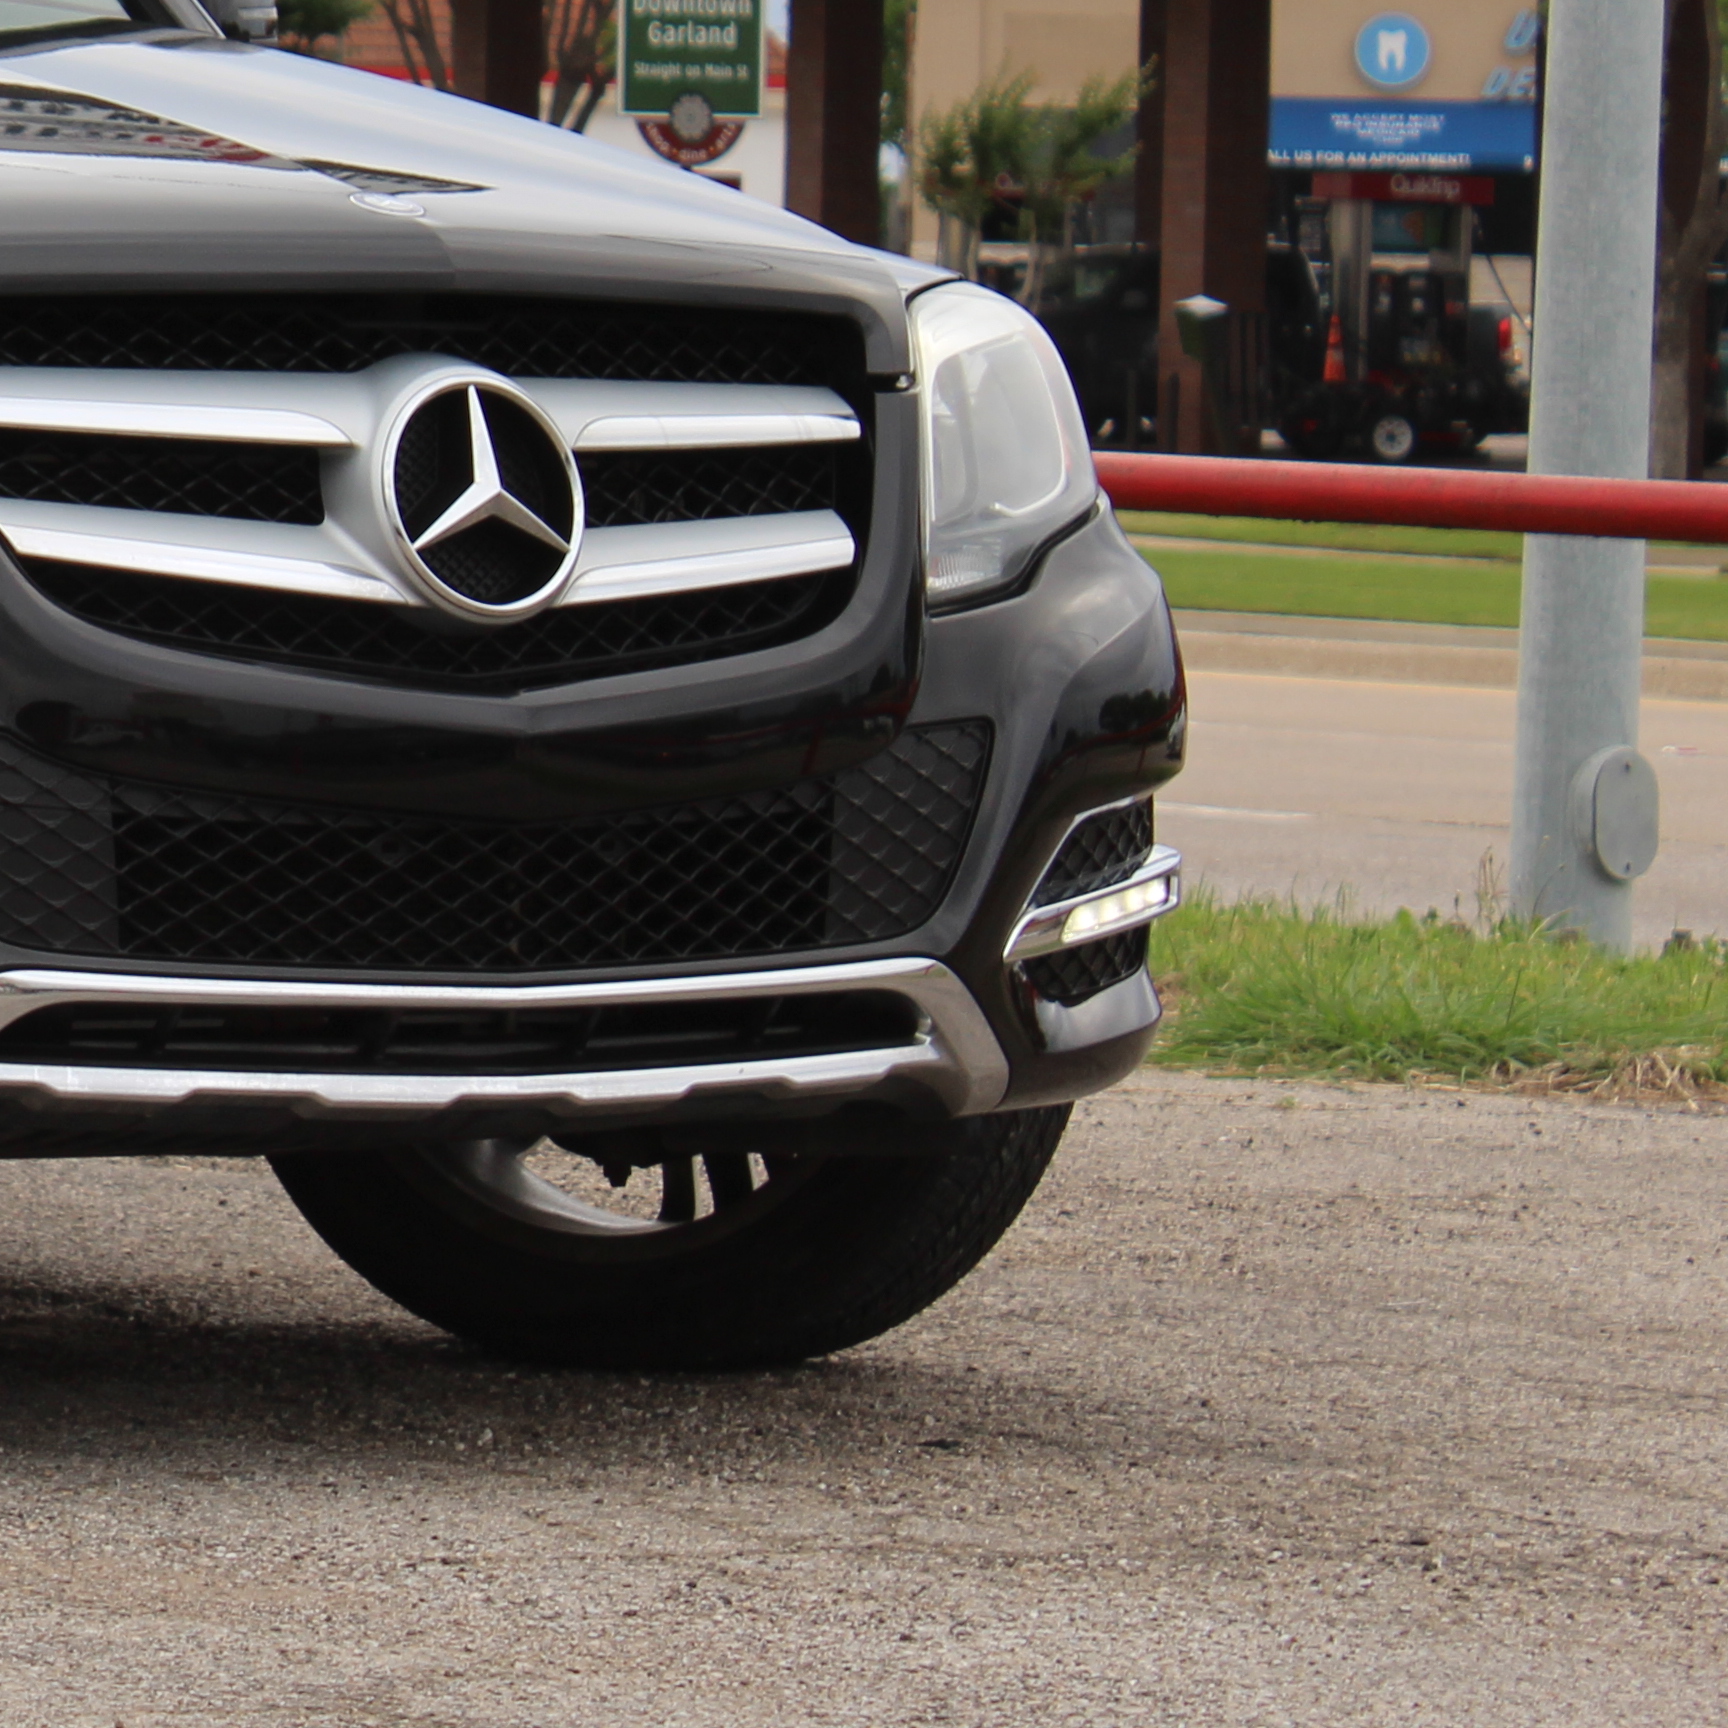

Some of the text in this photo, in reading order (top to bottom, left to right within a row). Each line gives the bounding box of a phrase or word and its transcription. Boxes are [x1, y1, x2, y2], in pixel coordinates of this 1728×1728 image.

[647, 19, 738, 49] Garland
[633, 60, 750, 84] Straight on Main St
[1268, 149, 1290, 166] ALL
[1294, 150, 1313, 166] US
[1316, 150, 1344, 166] FOR
[1347, 151, 1367, 167] AN
[1369, 151, 1471, 168] APPOINTMENT!
